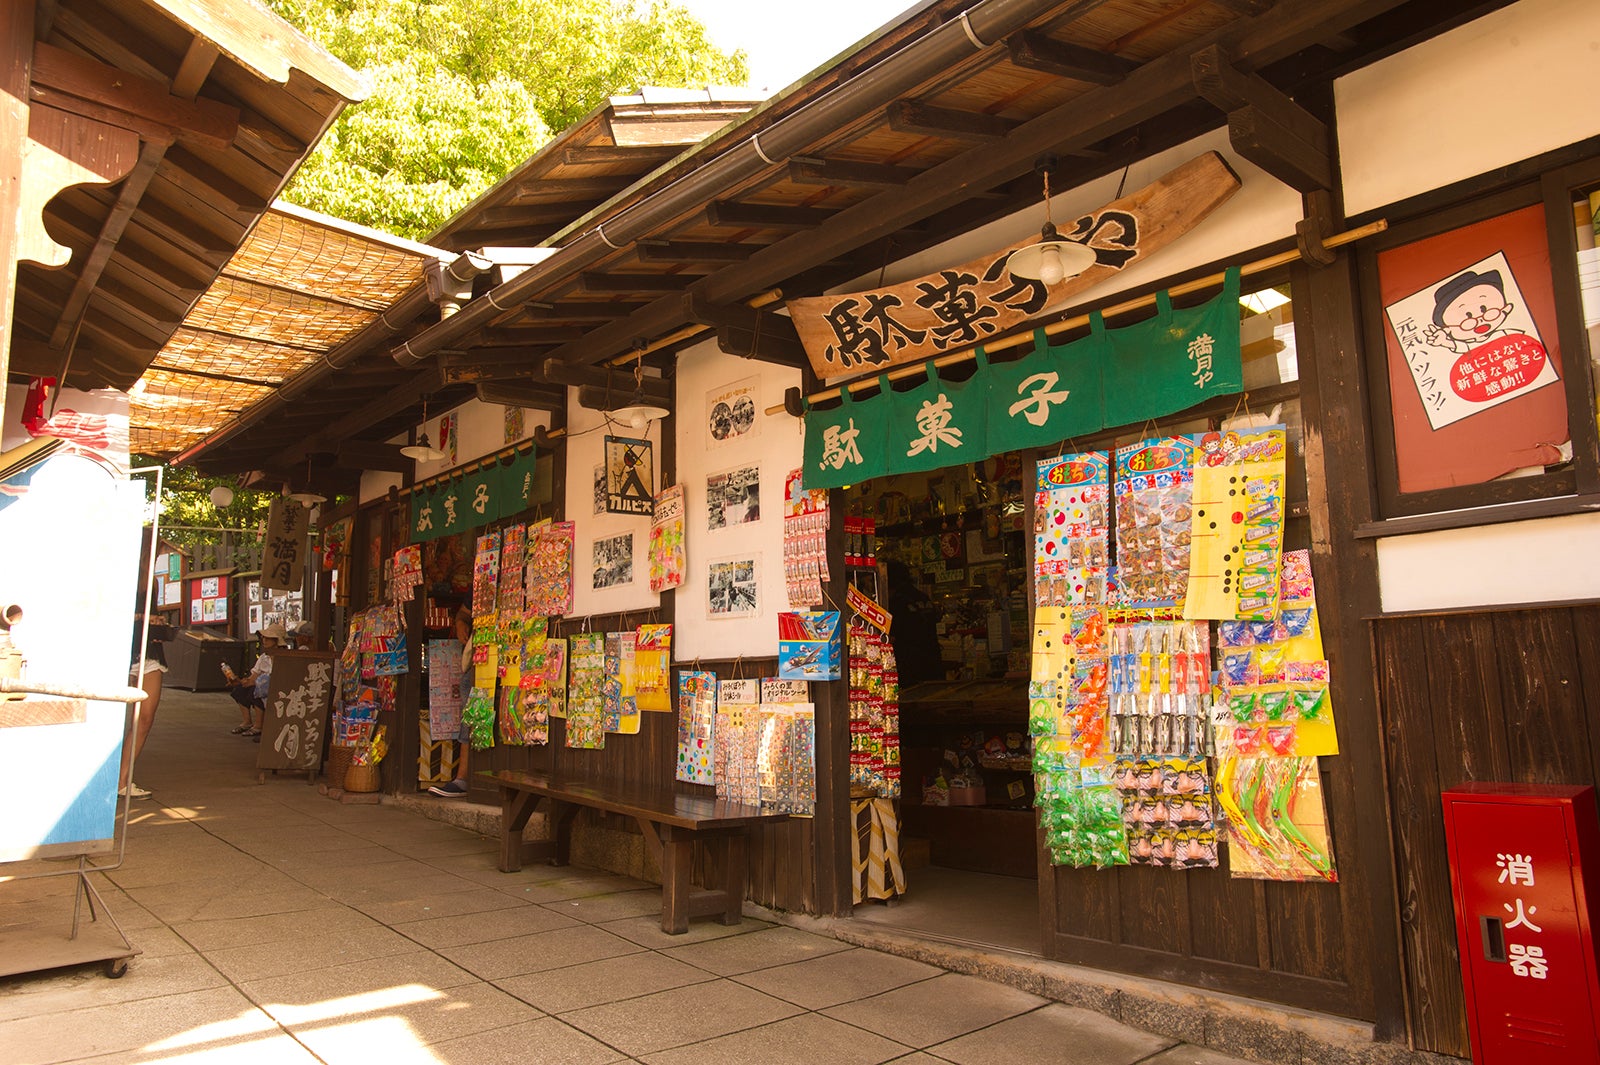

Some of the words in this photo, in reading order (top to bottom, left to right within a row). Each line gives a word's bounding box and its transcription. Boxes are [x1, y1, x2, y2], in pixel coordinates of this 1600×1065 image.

[1187, 335, 1216, 389] 満月や
[1396, 317, 1447, 411] 元気ハツラツ!
[1456, 350, 1543, 392] 新鮮な驚きと
[1459, 339, 1527, 375] 他にはない
[1485, 372, 1526, 396] 感動!!
[819, 371, 1070, 472] 駄菓子
[1052, 463, 1095, 483] おもちゃ
[1132, 449, 1181, 470] おもちゃ
[609, 495, 652, 513] カルピス
[270, 536, 299, 585] 満月
[274, 685, 307, 759] 満月
[1496, 853, 1549, 979] 消火器
